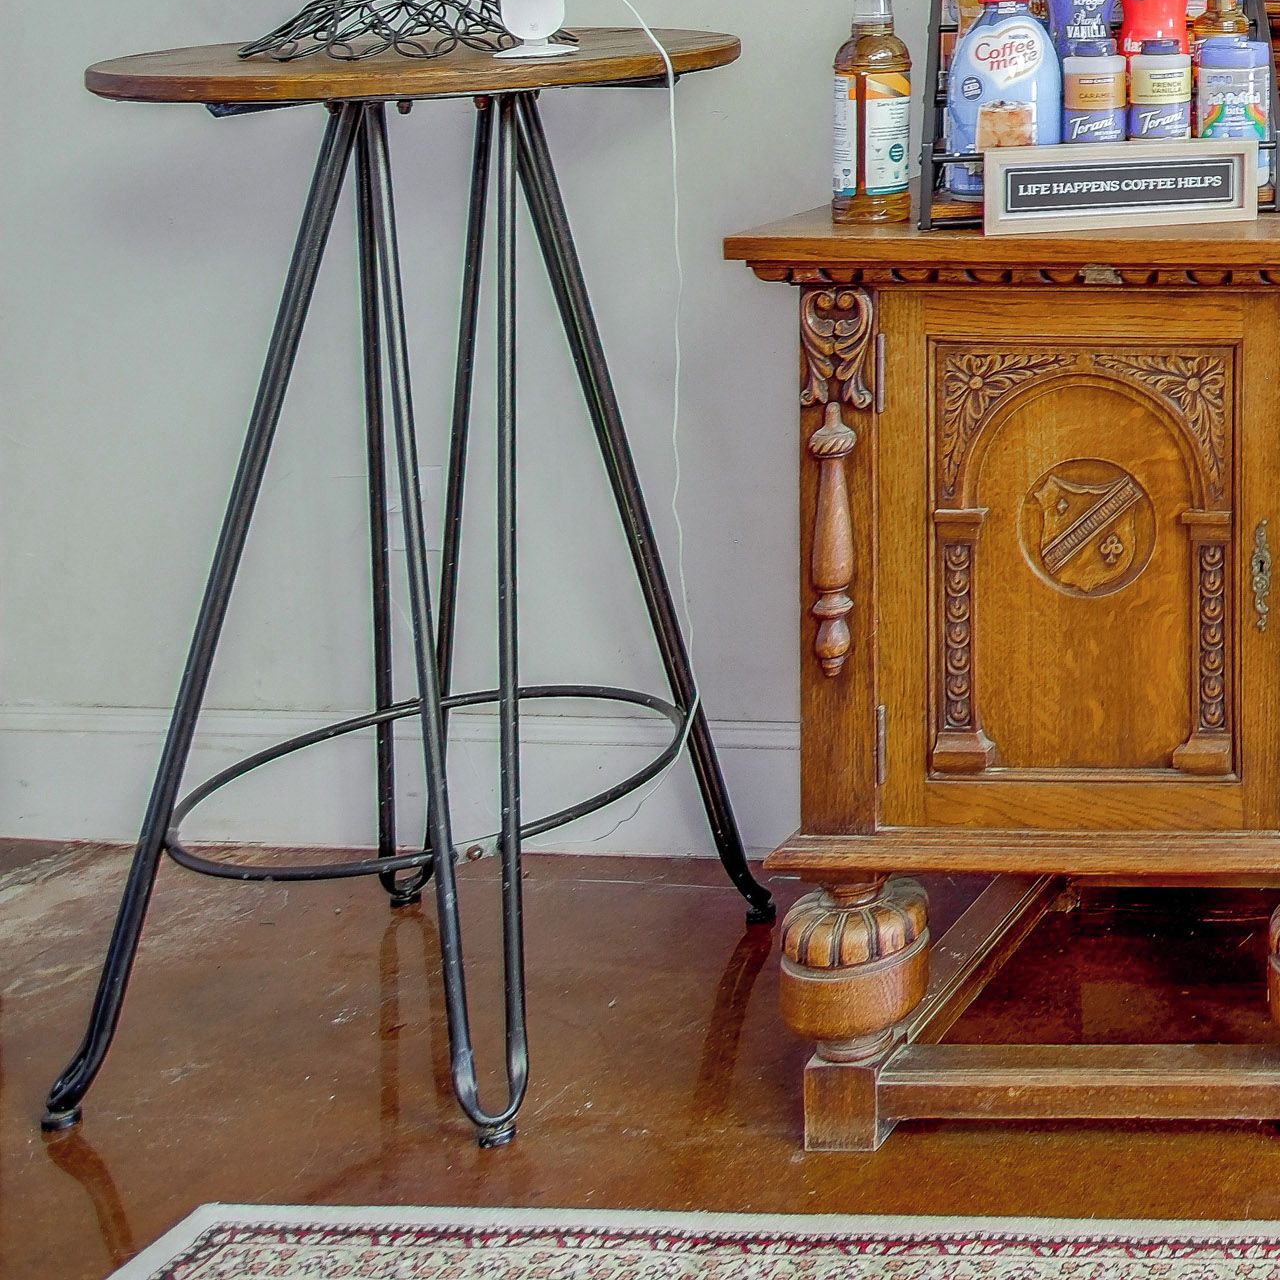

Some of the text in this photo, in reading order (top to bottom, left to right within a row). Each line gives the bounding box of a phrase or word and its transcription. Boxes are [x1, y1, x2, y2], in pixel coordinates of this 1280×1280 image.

[975, 39, 1035, 61] Coffee
[1069, 114, 1116, 140] Torani
[1138, 108, 1185, 136] Torani
[1018, 175, 1223, 196] LIFE HAPPENS COFFEE HELPS
